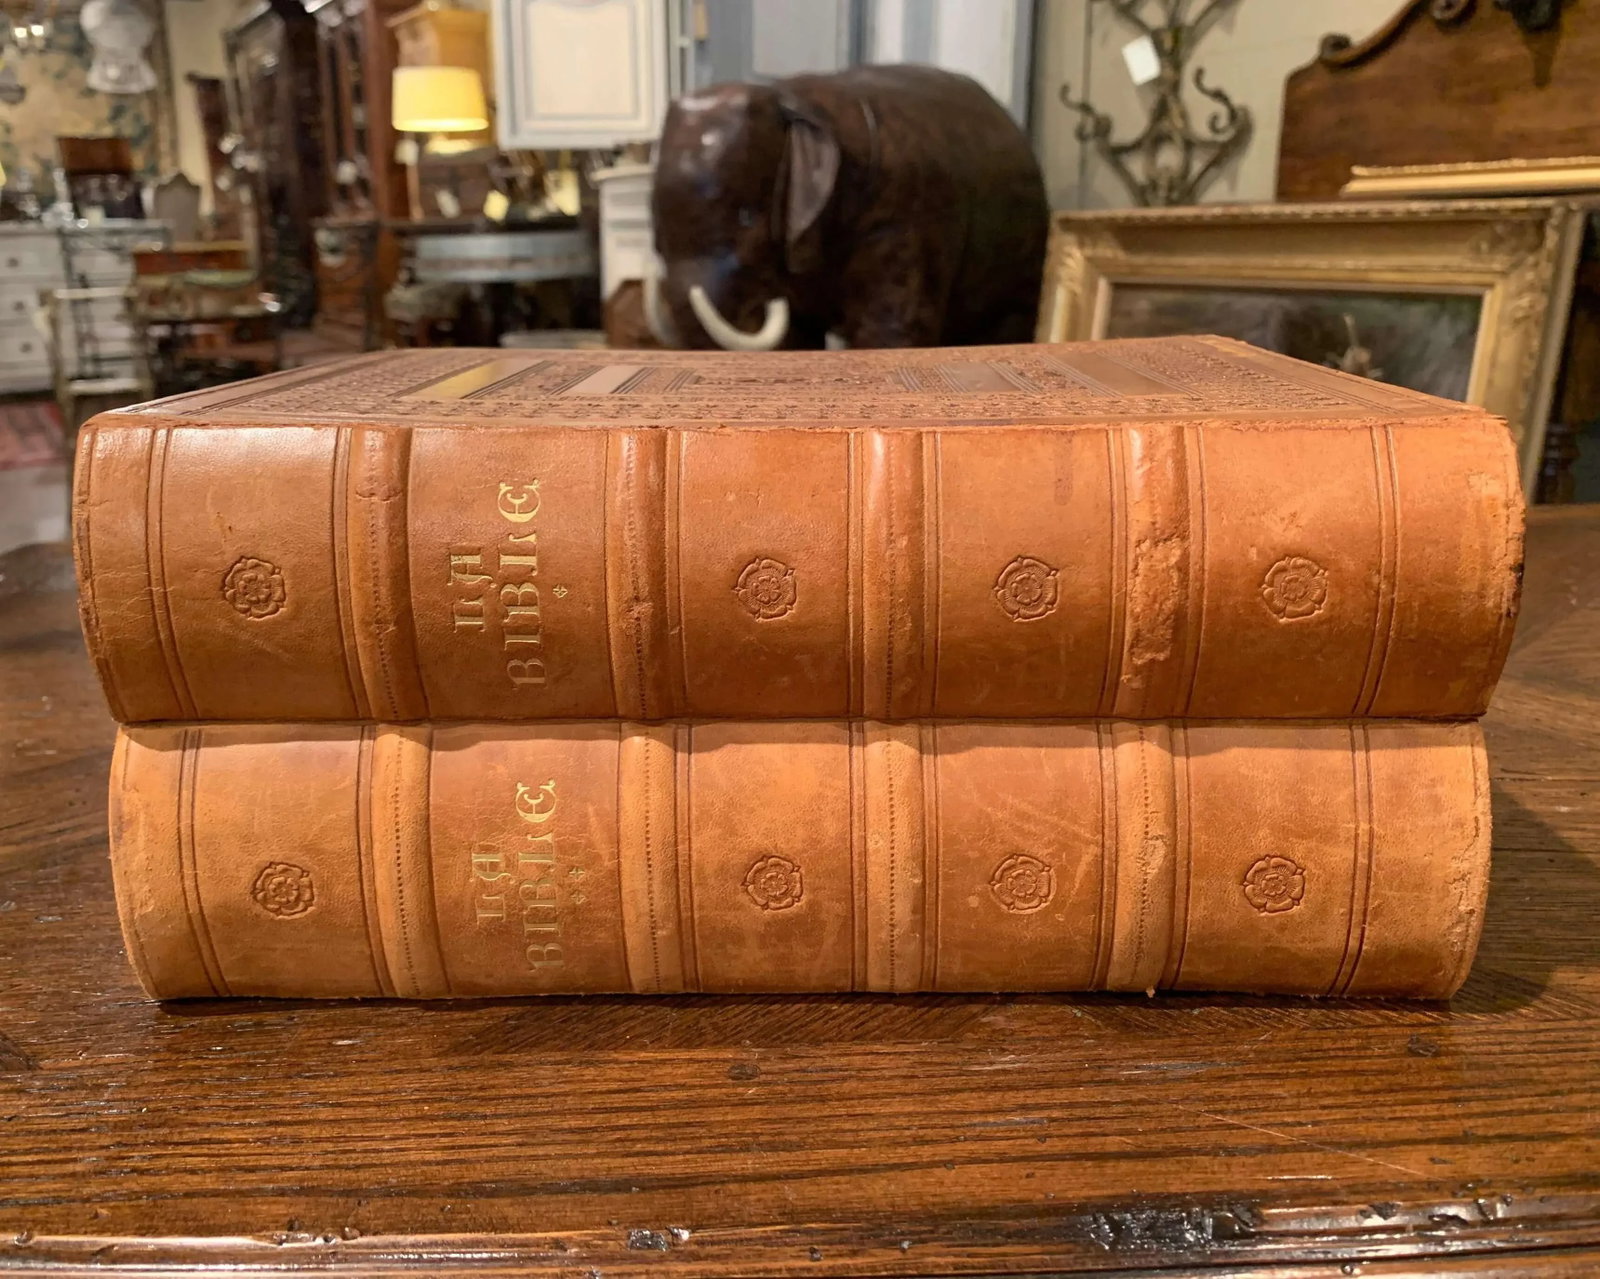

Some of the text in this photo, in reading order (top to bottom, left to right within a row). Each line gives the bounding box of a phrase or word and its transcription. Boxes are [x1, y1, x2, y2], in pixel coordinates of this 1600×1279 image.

[447, 549, 497, 633] LA
[498, 478, 547, 690] BIBLE
[469, 845, 515, 927] LA
[515, 779, 564, 973] BIBLE
